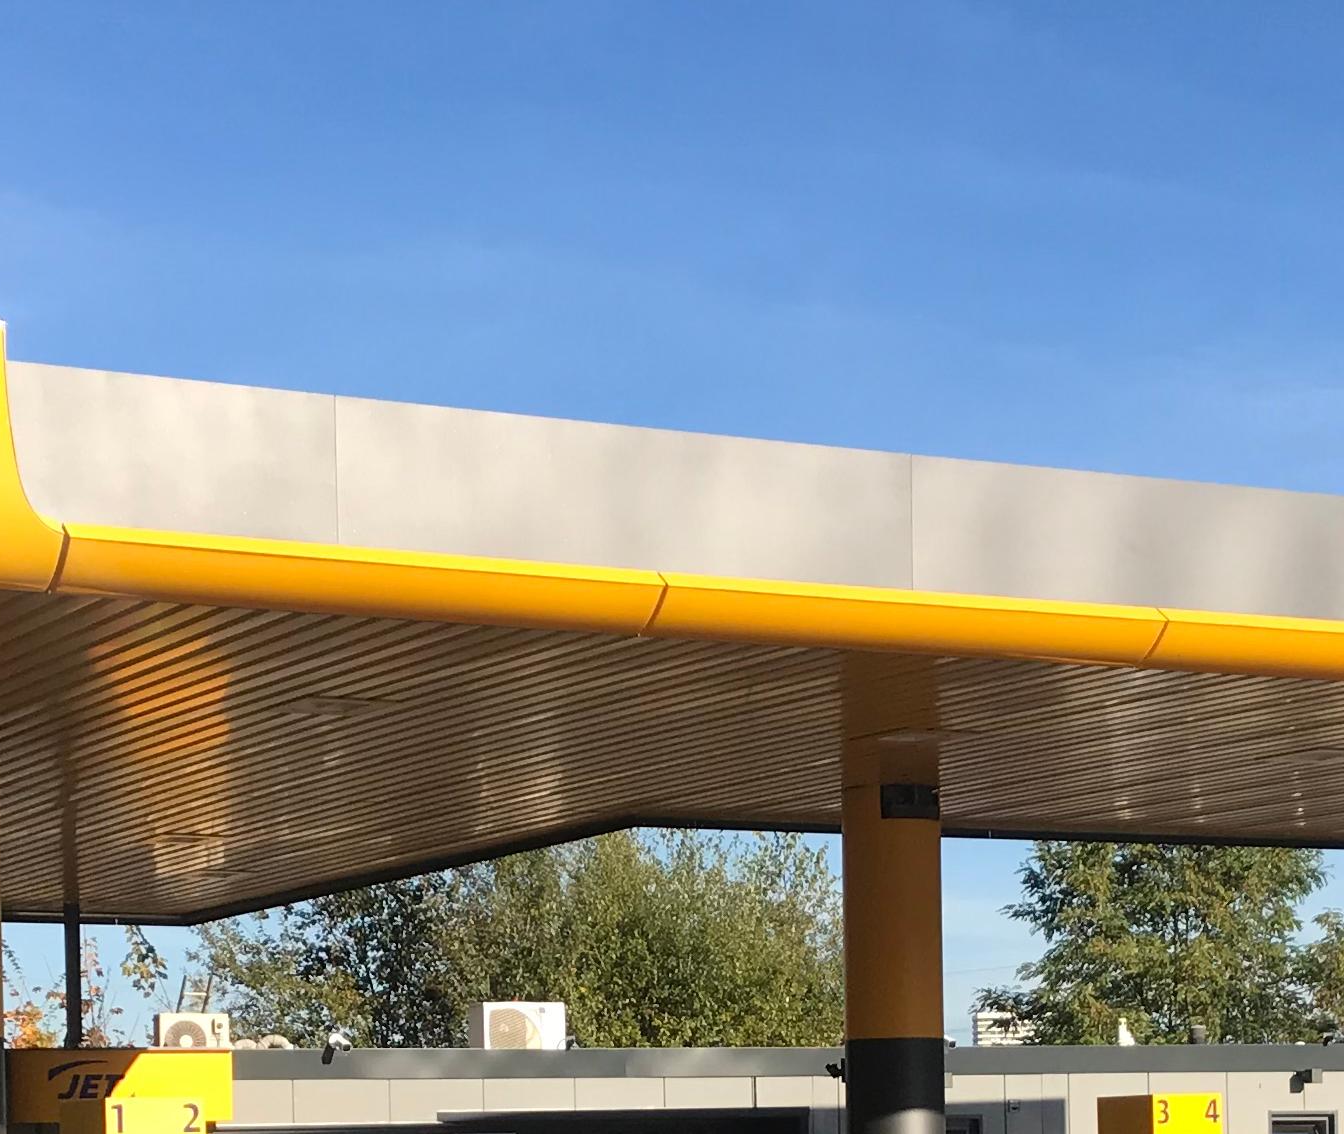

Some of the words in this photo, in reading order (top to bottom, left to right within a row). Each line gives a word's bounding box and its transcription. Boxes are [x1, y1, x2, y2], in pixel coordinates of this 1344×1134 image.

[57, 1073, 126, 1099] JET
[111, 1104, 123, 1133] 1
[183, 1103, 201, 1132] 2
[1157, 1099, 1169, 1124] 3
[1205, 1098, 1220, 1123] 4
